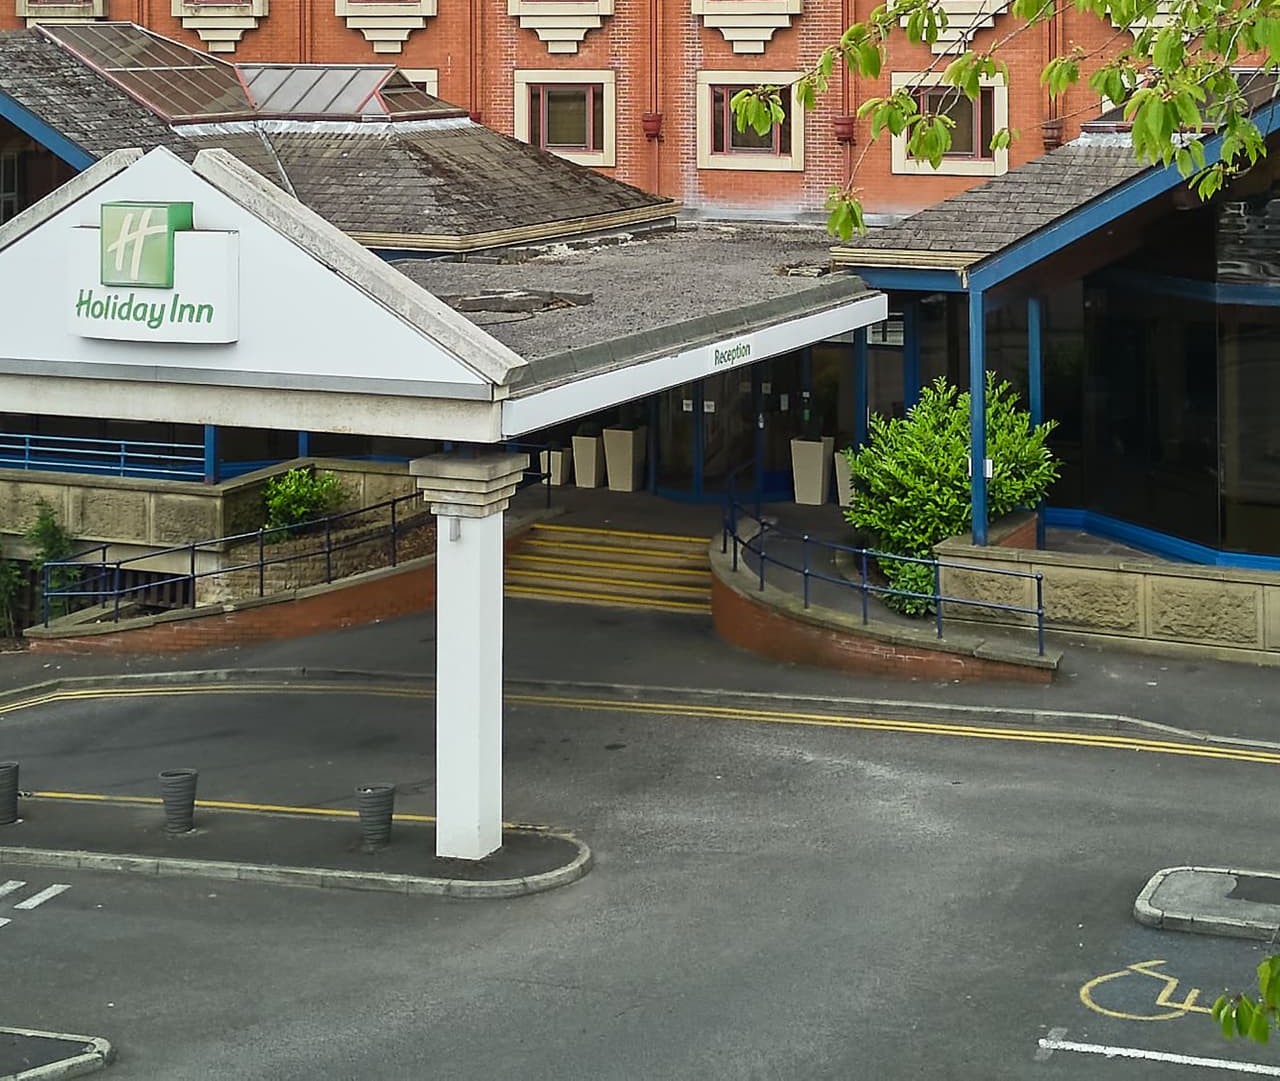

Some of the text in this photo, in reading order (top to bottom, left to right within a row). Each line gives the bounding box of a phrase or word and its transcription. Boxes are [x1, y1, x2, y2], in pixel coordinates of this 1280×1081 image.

[76, 289, 214, 329] Holiday Inn
[714, 343, 751, 366] Reception
